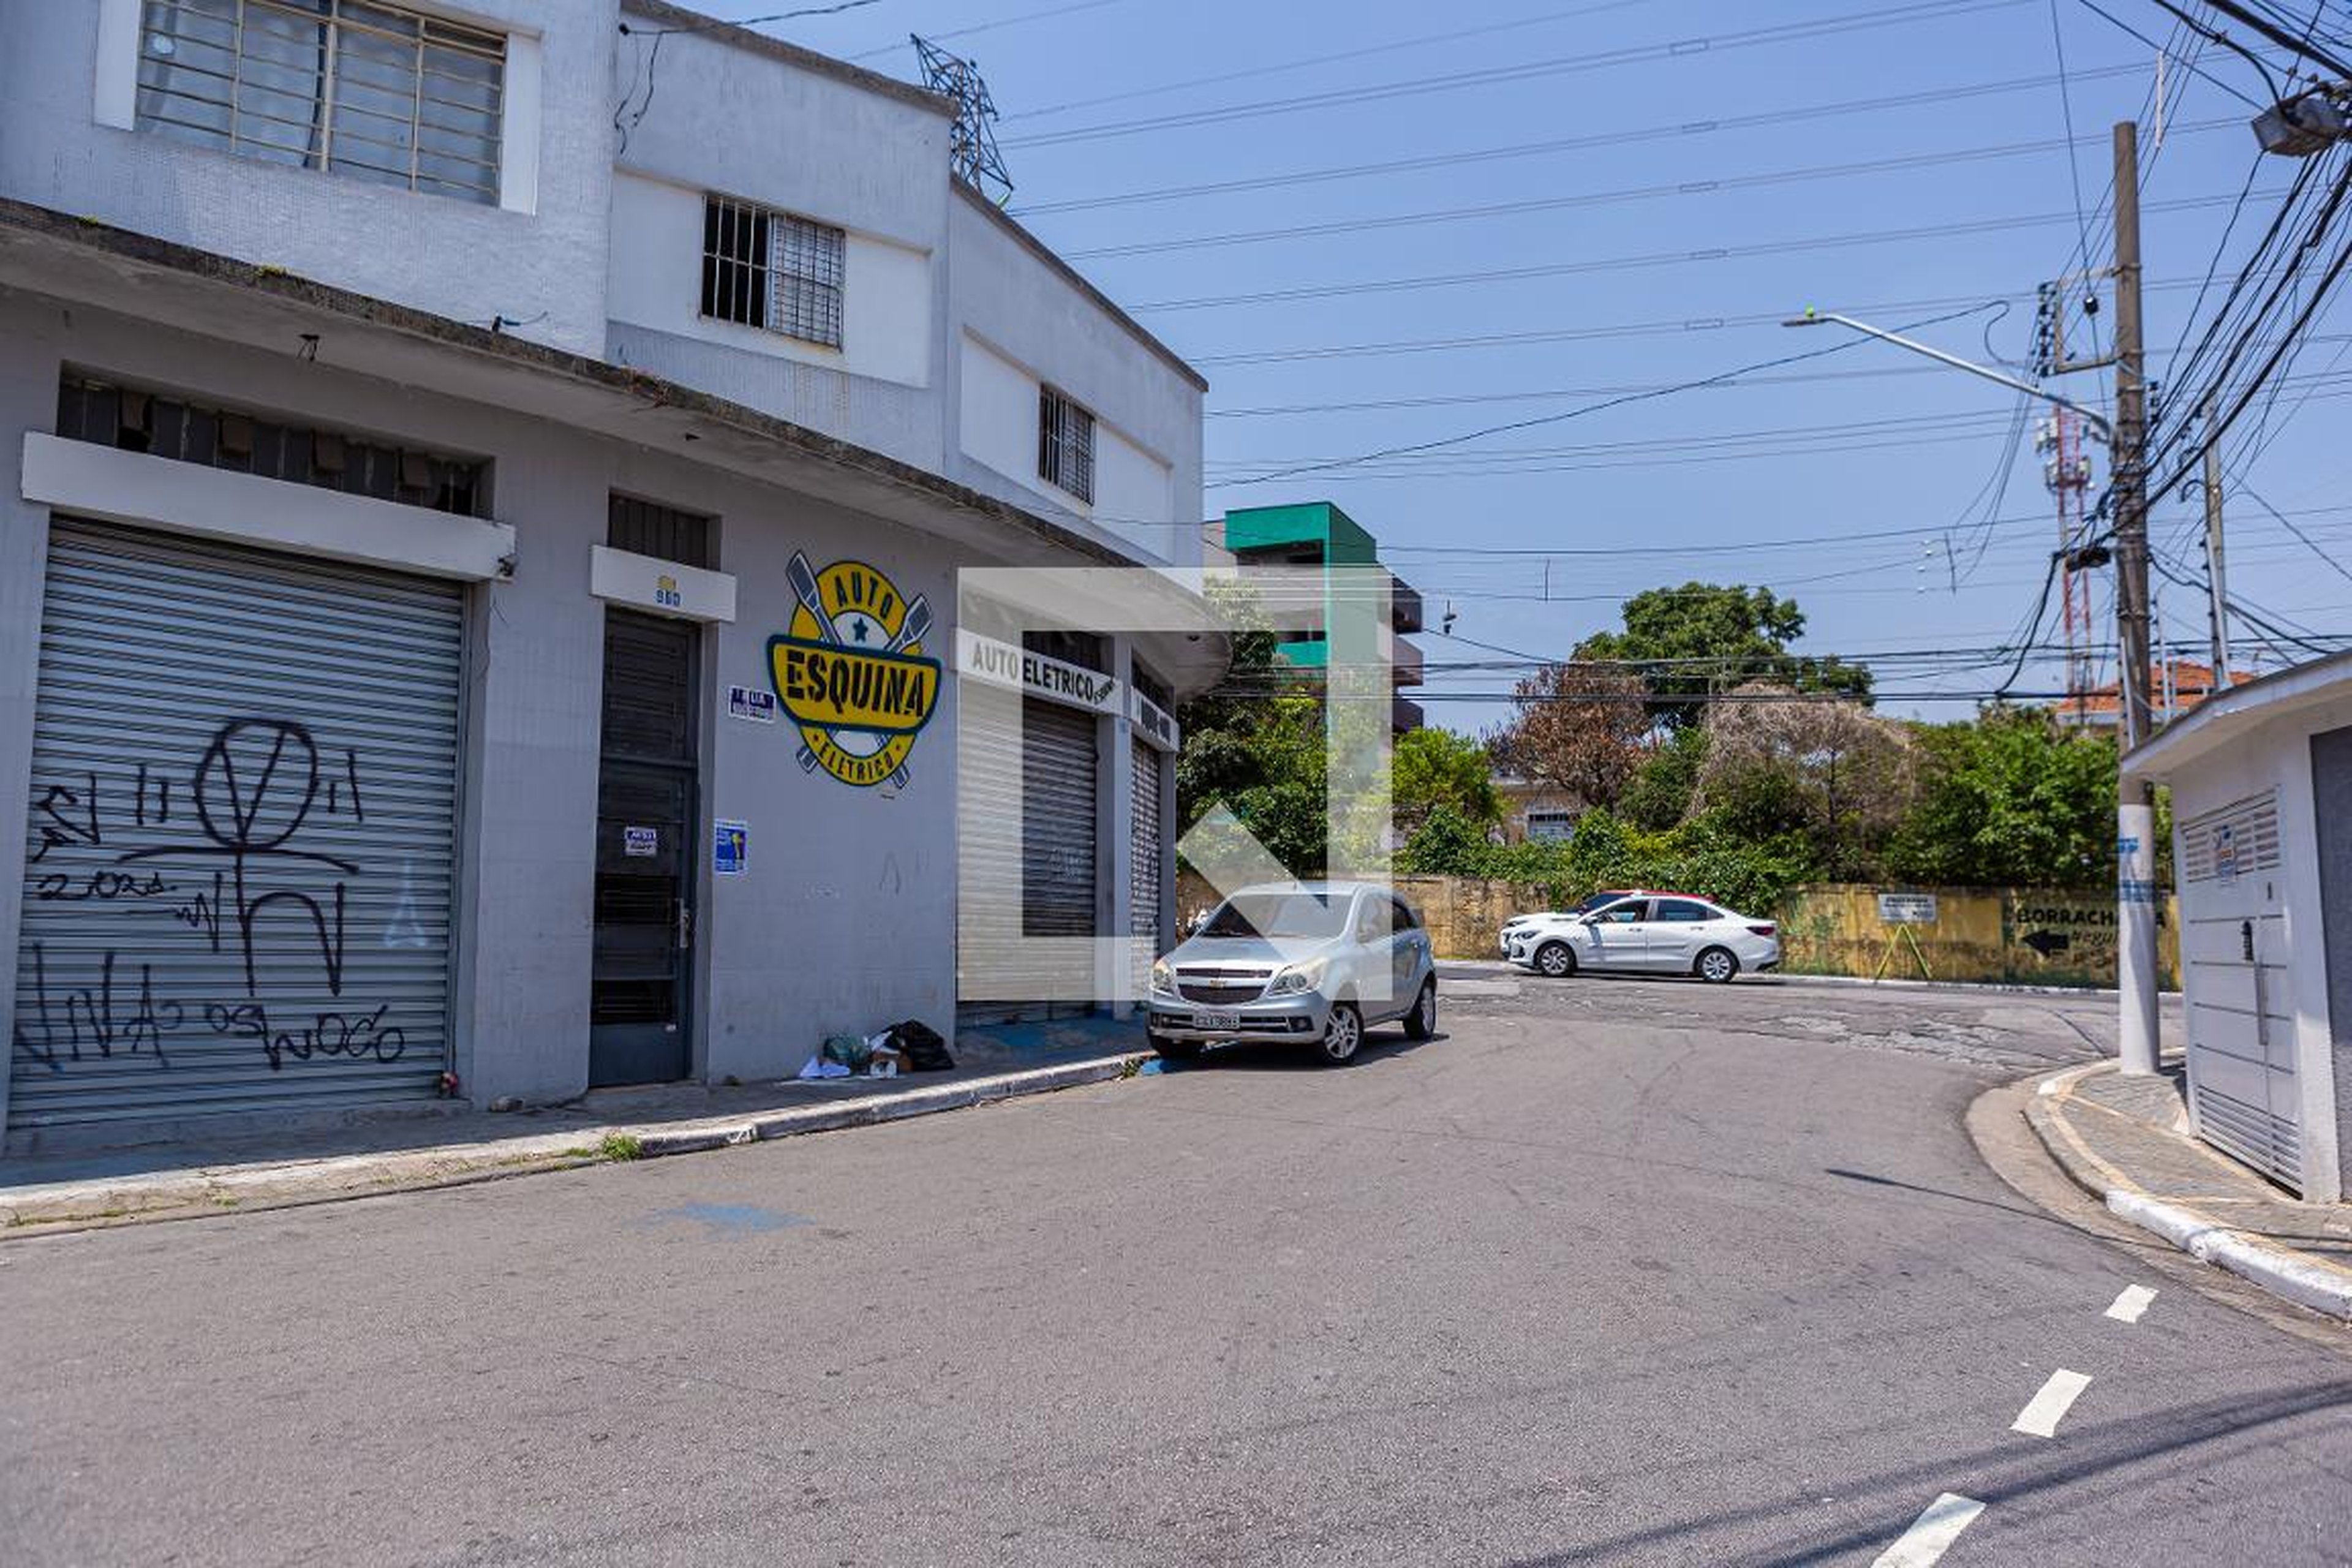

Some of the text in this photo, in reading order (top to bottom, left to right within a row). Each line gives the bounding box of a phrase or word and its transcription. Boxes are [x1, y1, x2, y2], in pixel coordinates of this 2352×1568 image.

[835, 571, 894, 620] AUTO
[786, 649, 924, 717] ESQUINA
[973, 642, 1018, 680] AUTO
[1023, 657, 1094, 702] ELETRICO
[2017, 908, 2166, 929] BORRACHA
